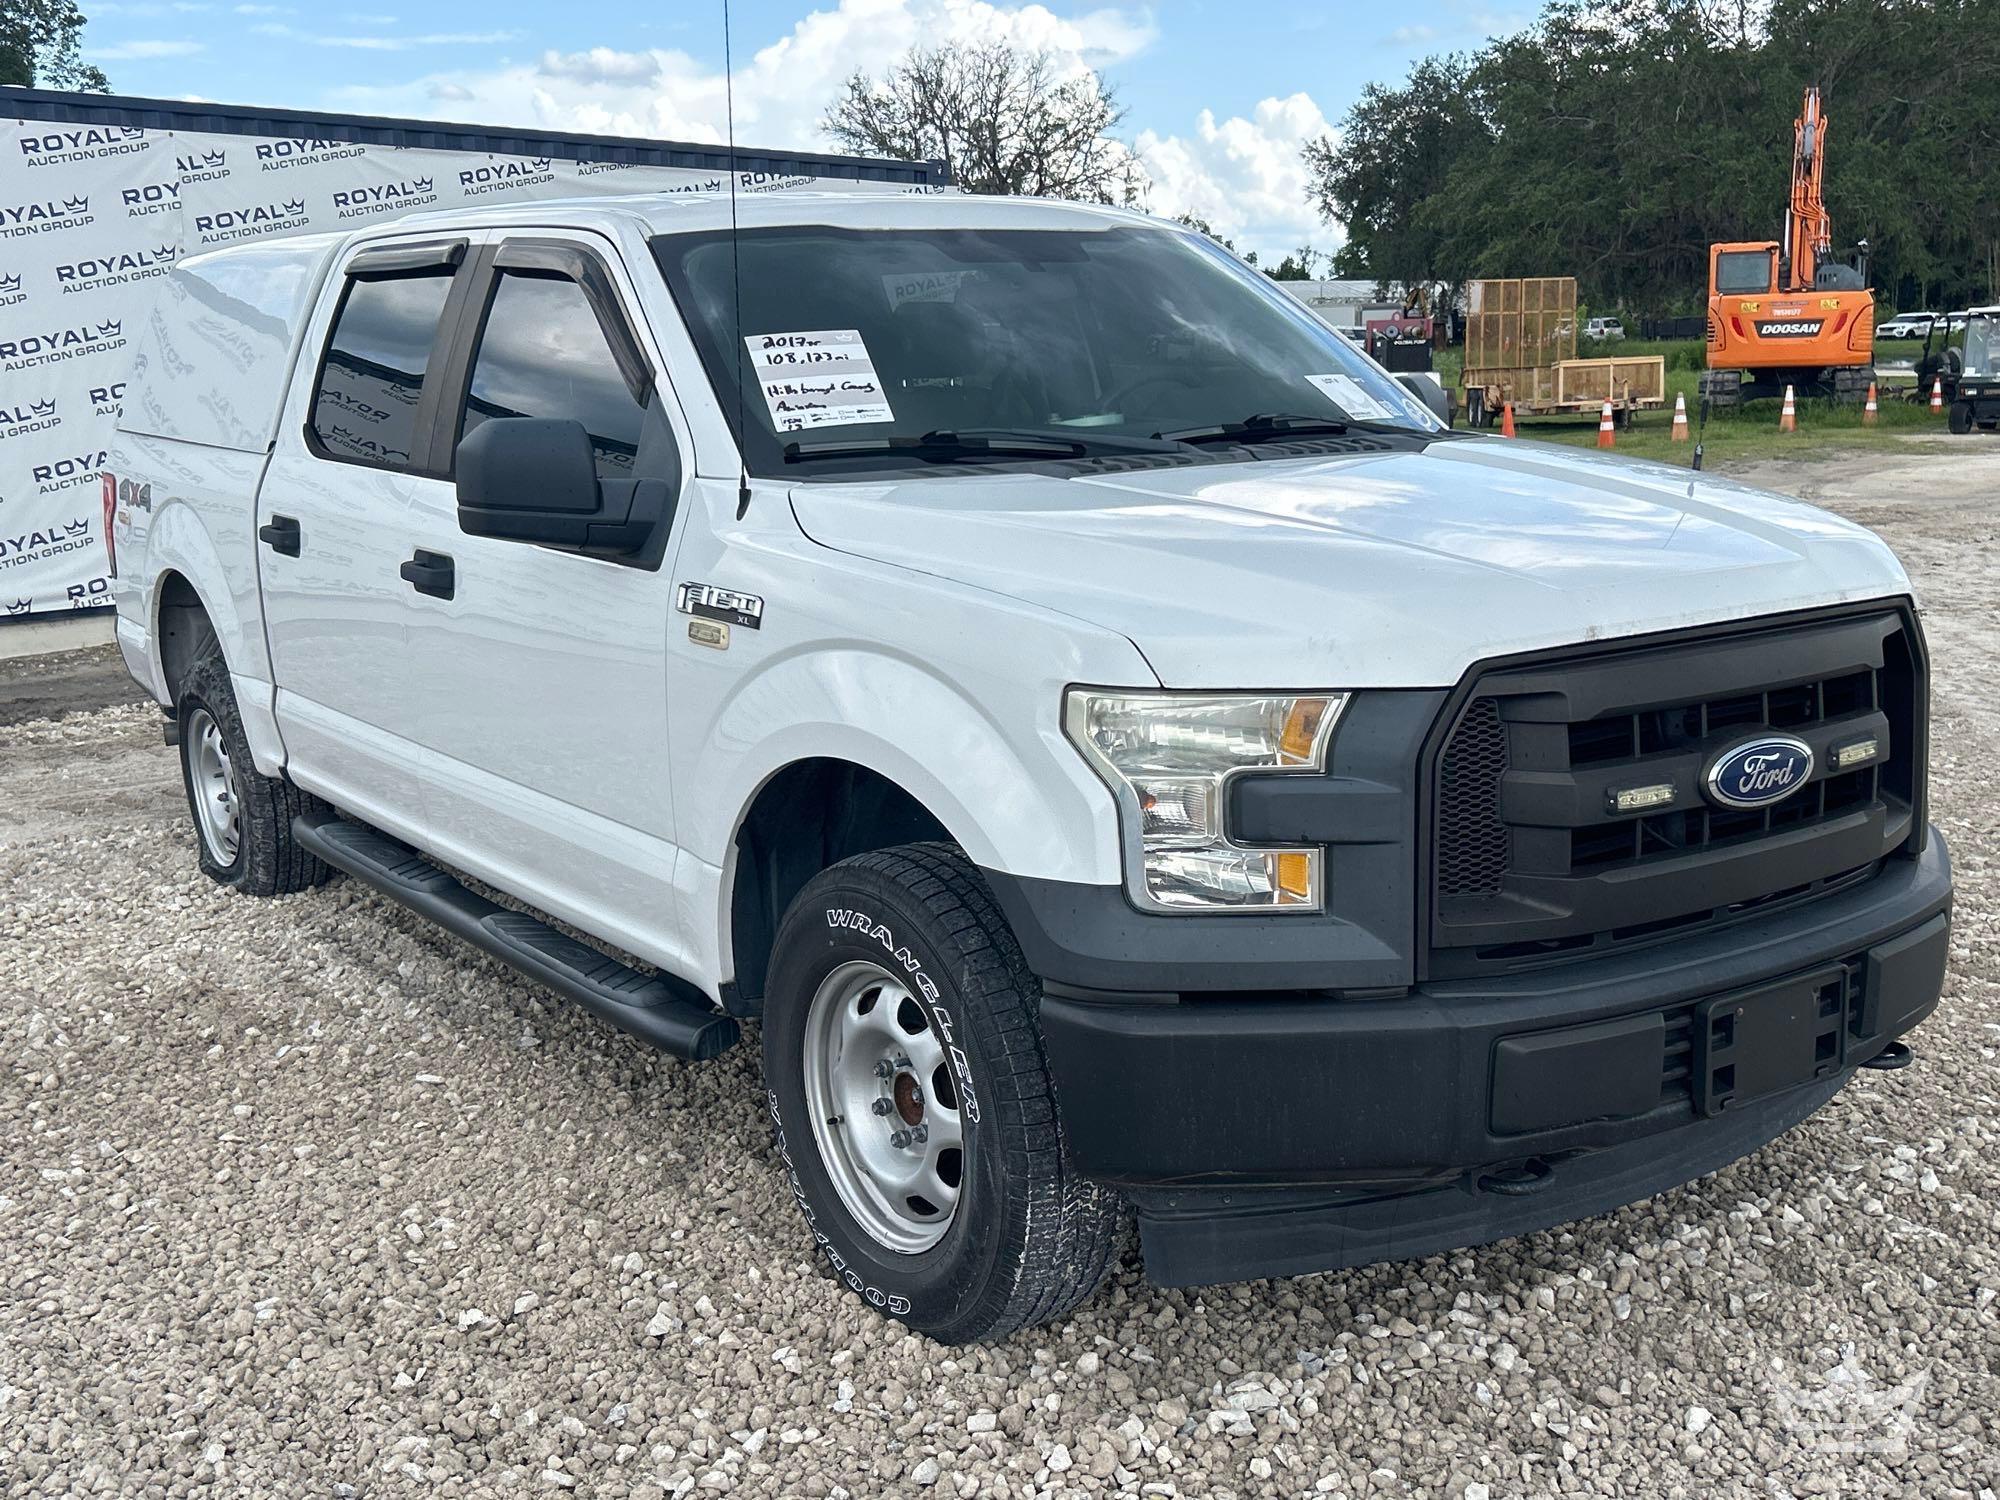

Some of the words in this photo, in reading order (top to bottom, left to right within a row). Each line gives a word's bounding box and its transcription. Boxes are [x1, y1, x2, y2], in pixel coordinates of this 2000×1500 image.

[20, 128, 121, 154] ROYAL
[27, 151, 95, 167] AUCTION
[98, 142, 150, 158] GROUP
[261, 155, 319, 172] AUCTION
[321, 148, 366, 162] GROUP
[182, 169, 231, 184] GROUP
[459, 161, 533, 186] ROYAL
[463, 181, 514, 197] AUCTION
[516, 174, 555, 187] GROUP
[785, 176, 817, 189] GROUP
[122, 182, 180, 205] ROY
[333, 182, 414, 208] ROYAL
[128, 201, 182, 218] AUCTIO
[195, 205, 285, 232] ROYAL
[338, 202, 394, 219] AUCTION
[395, 194, 438, 209] GROUP
[41, 216, 95, 232] GROUP
[201, 226, 262, 245] AUCTION
[264, 217, 310, 233] GROUP
[56, 252, 153, 282] ROYAL
[62, 274, 128, 294] AUCTION
[131, 266, 171, 281] GROU
[1761, 323, 1821, 335] DOOSAN
[0, 327, 99, 359] ROYAL
[5, 350, 72, 372] AUCTION
[75, 338, 127, 356] GROUP
[8, 417, 61, 437] GROUP
[42, 537, 94, 558] GROUP
[737, 615, 750, 625] XL
[1739, 752, 1795, 794] Ford
[826, 908, 981, 1124] WRANGLER
